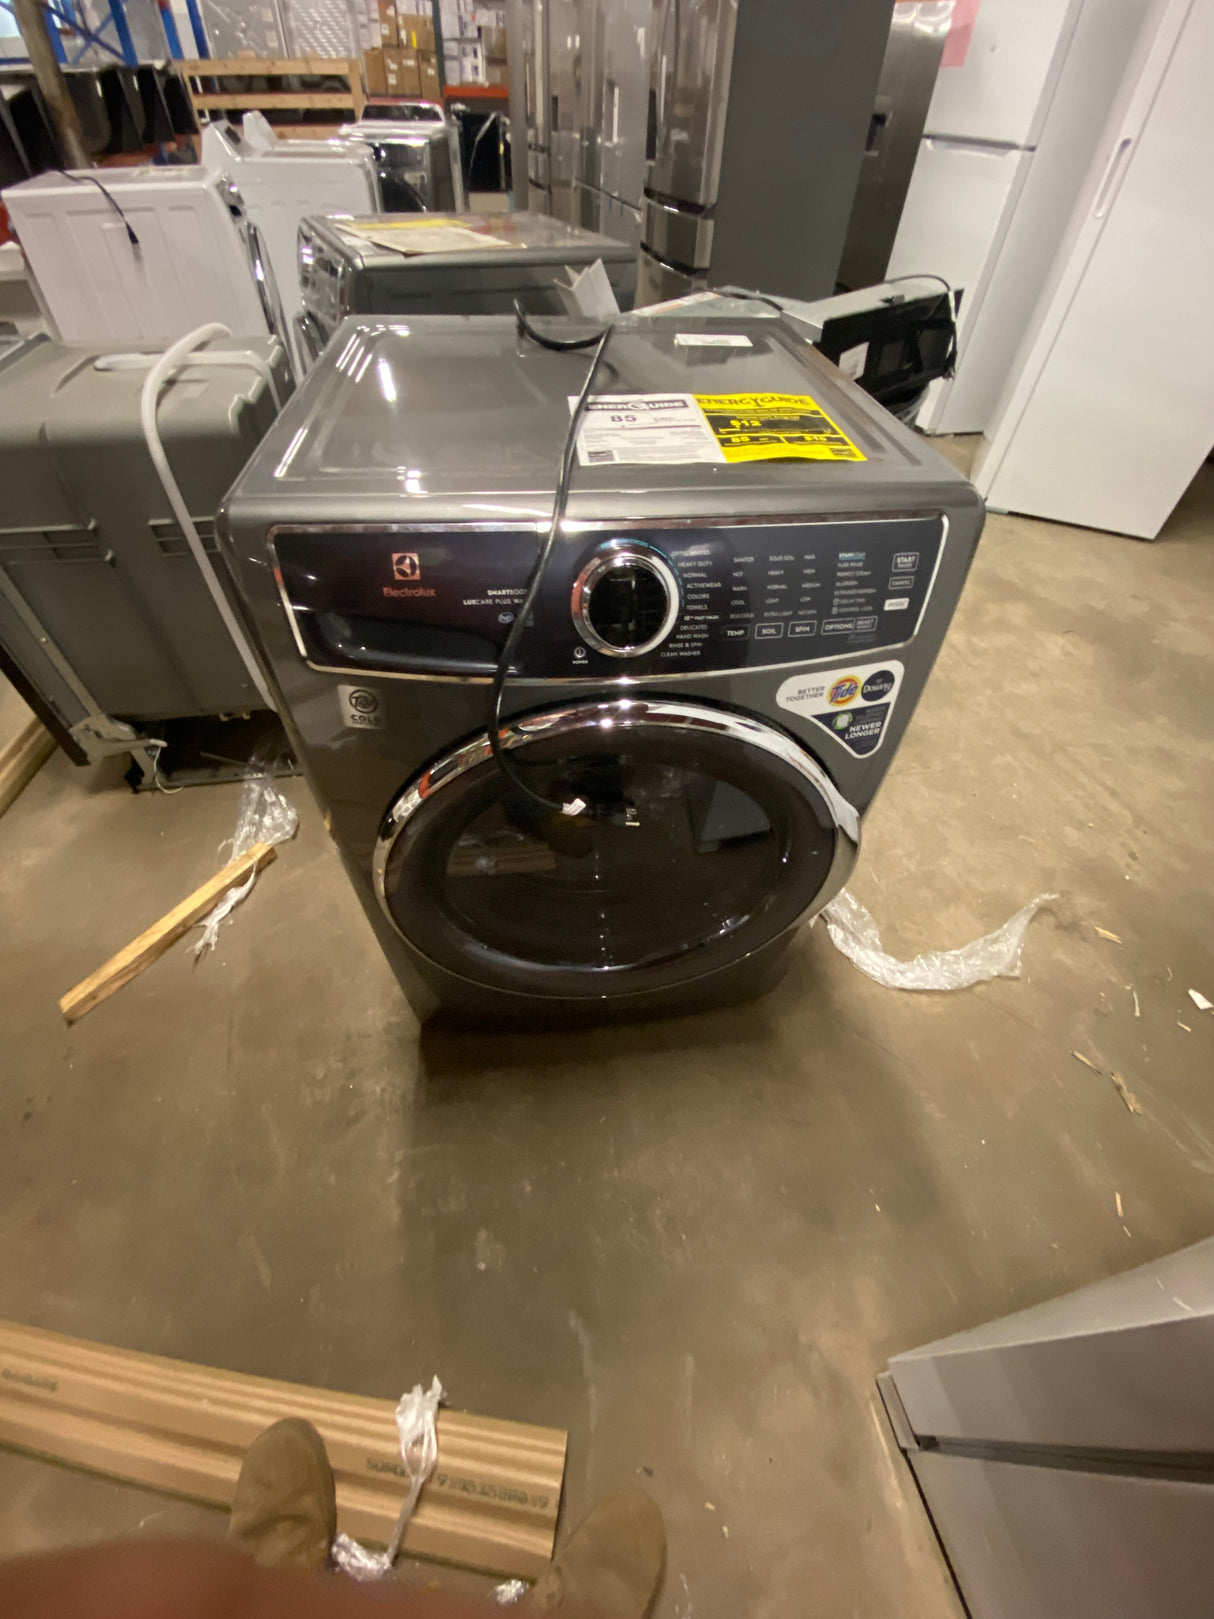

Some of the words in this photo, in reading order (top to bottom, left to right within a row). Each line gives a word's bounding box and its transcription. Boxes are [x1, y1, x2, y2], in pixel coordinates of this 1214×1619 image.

[383, 587, 437, 597] Electrolux
[798, 686, 826, 695] BETTER
[830, 683, 859, 703] Tide
[862, 683, 892, 694] Downy
[786, 692, 825, 703] TOGETHER
[849, 721, 882, 733] NEWER
[845, 728, 880, 740] LONGER
